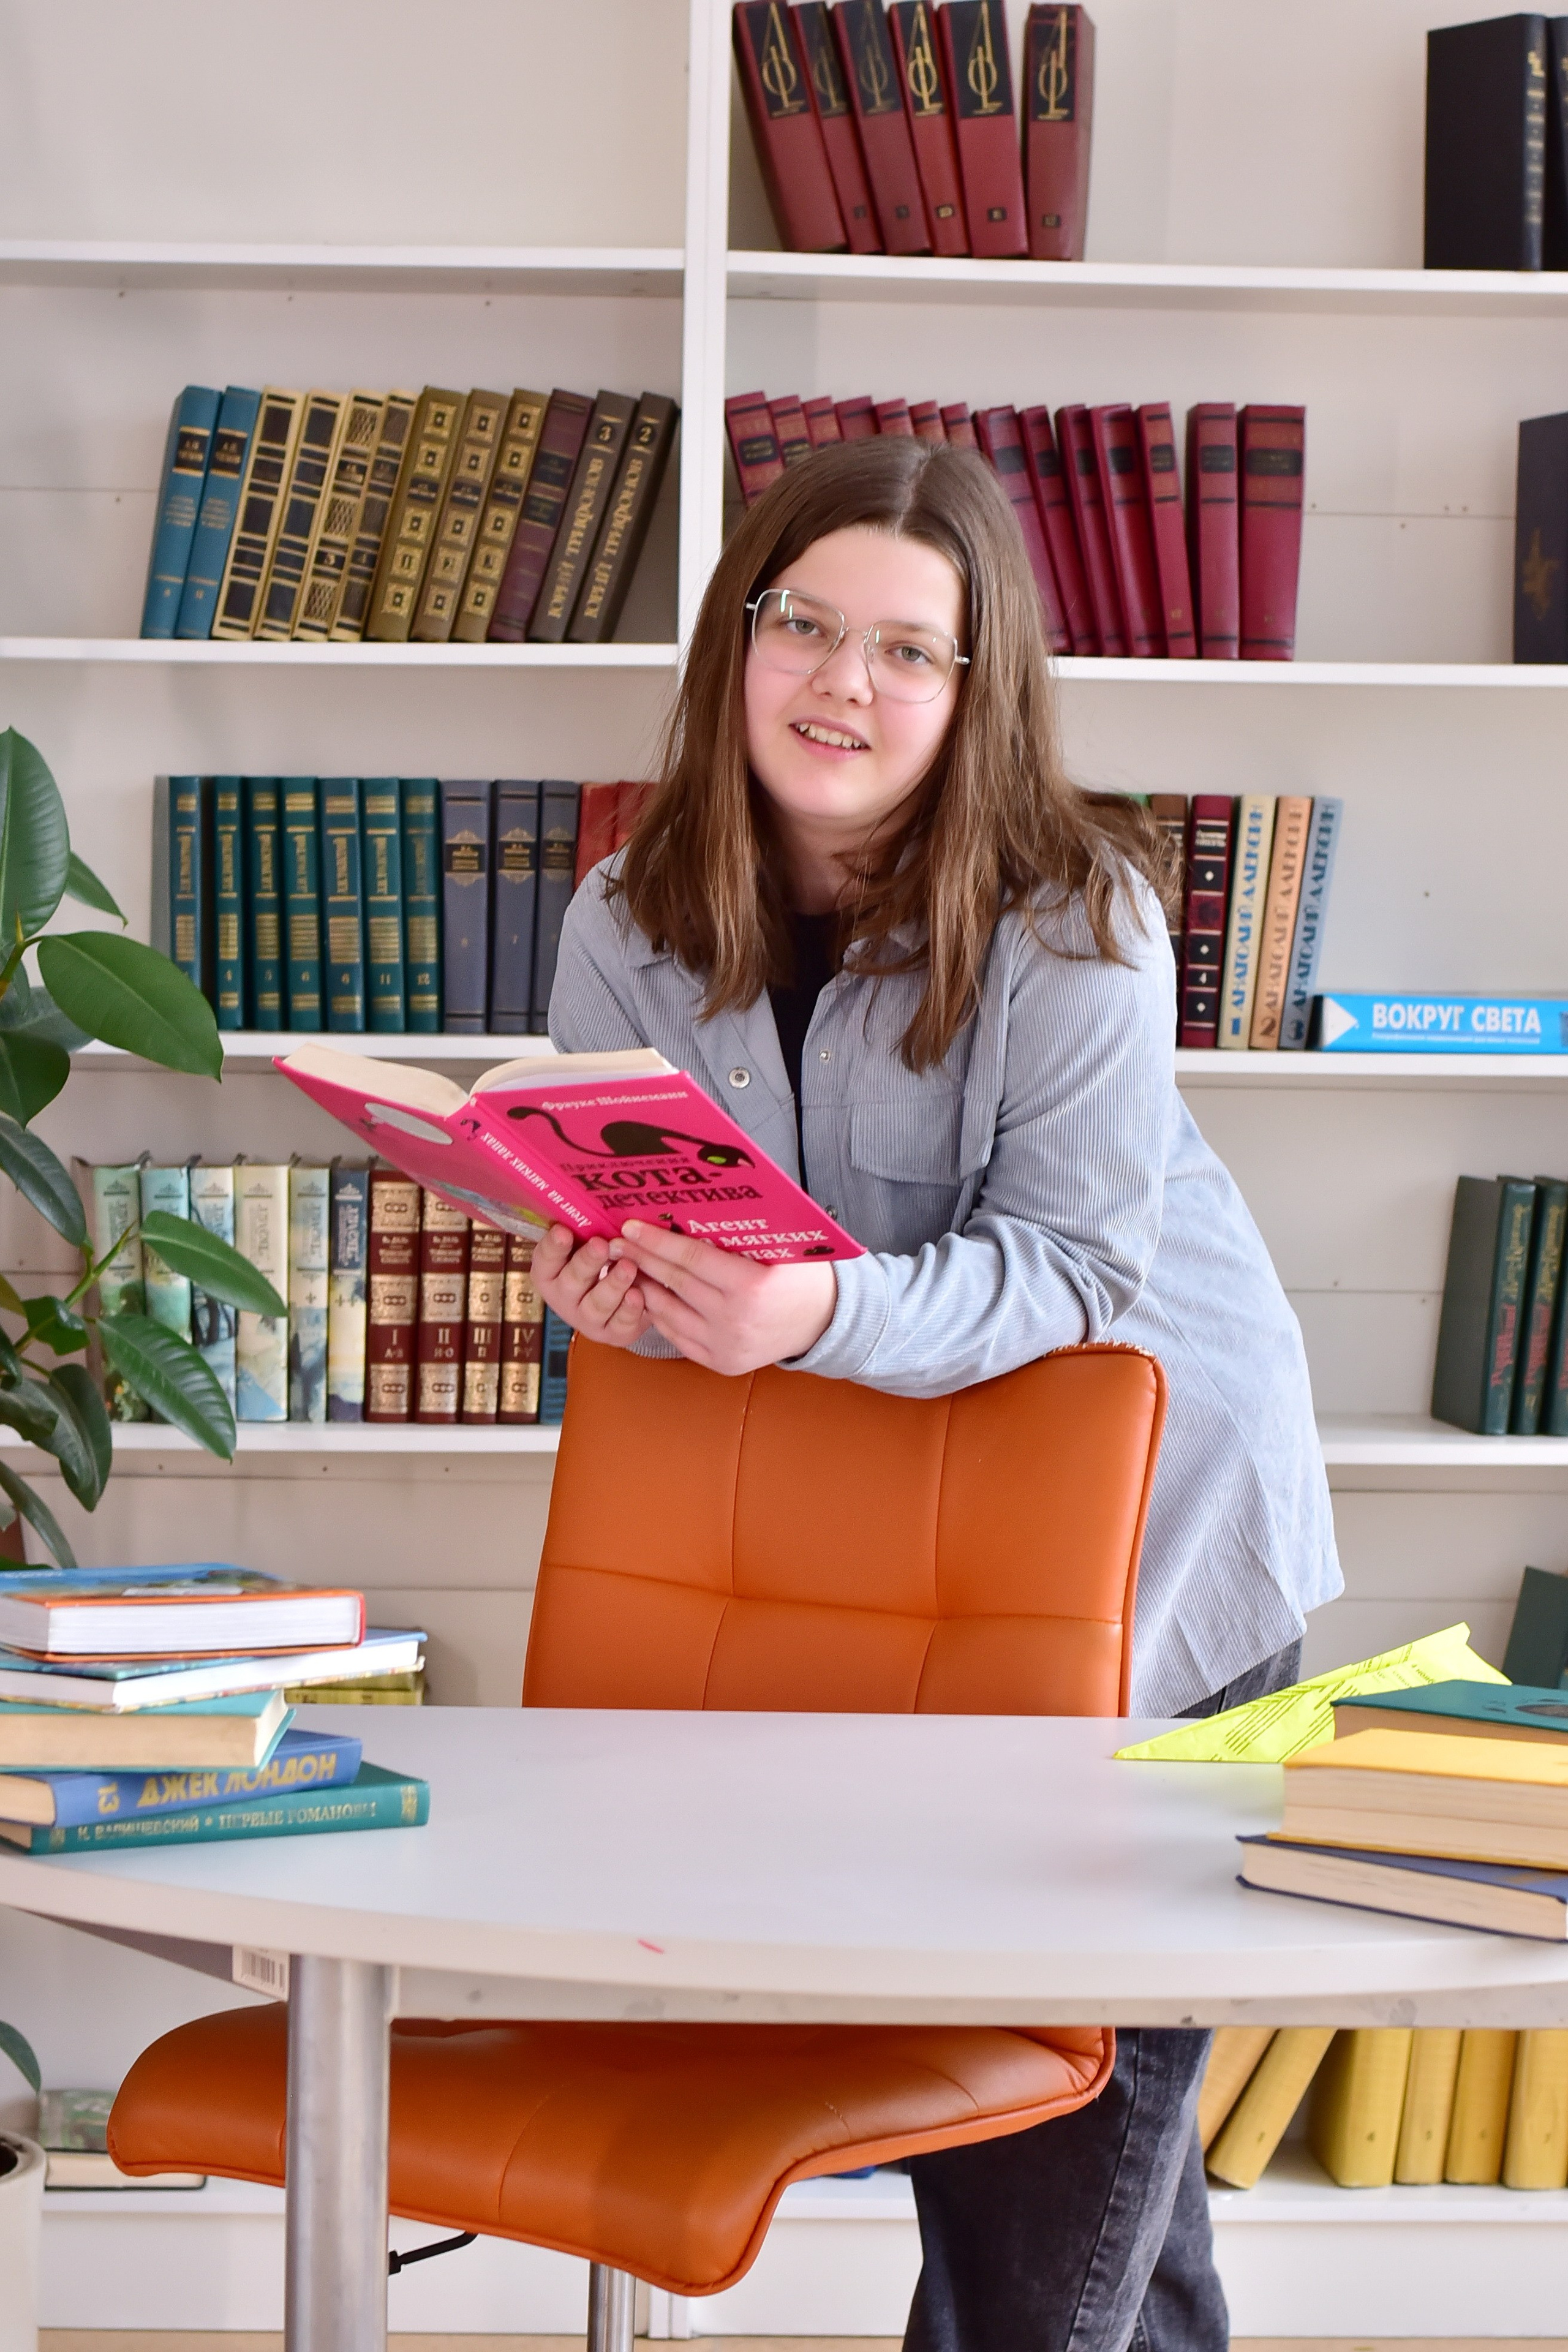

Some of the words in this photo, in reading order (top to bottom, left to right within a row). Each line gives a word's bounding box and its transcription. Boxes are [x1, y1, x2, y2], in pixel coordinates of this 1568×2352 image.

[639, 426, 652, 443] 2
[1242, 804, 1263, 902] АЛЕКСИН
[1309, 804, 1335, 902] АЛЕКСИН
[1232, 904, 1253, 1011] АНАТОЛИЙ
[1260, 1016, 1277, 1037] 2
[1373, 1003, 1465, 1030] ВОКРУГ
[1471, 1006, 1541, 1033] СВЕТА
[480, 1131, 515, 1161] лапах
[510, 1157, 550, 1191] мягких
[547, 1189, 565, 1205] на
[596, 1185, 763, 1211] детектива
[560, 1201, 592, 1228] Агент
[687, 1218, 769, 1234] Агент
[718, 1230, 830, 1247] мягких
[473, 1327, 491, 1344] III
[513, 1327, 535, 1344] IV
[97, 1782, 121, 1815] 13
[137, 1773, 219, 1807] ДЖЕК
[224, 1753, 337, 1795] ЛОНДОН
[219, 1810, 284, 1830] ПЕРВЫЕ
